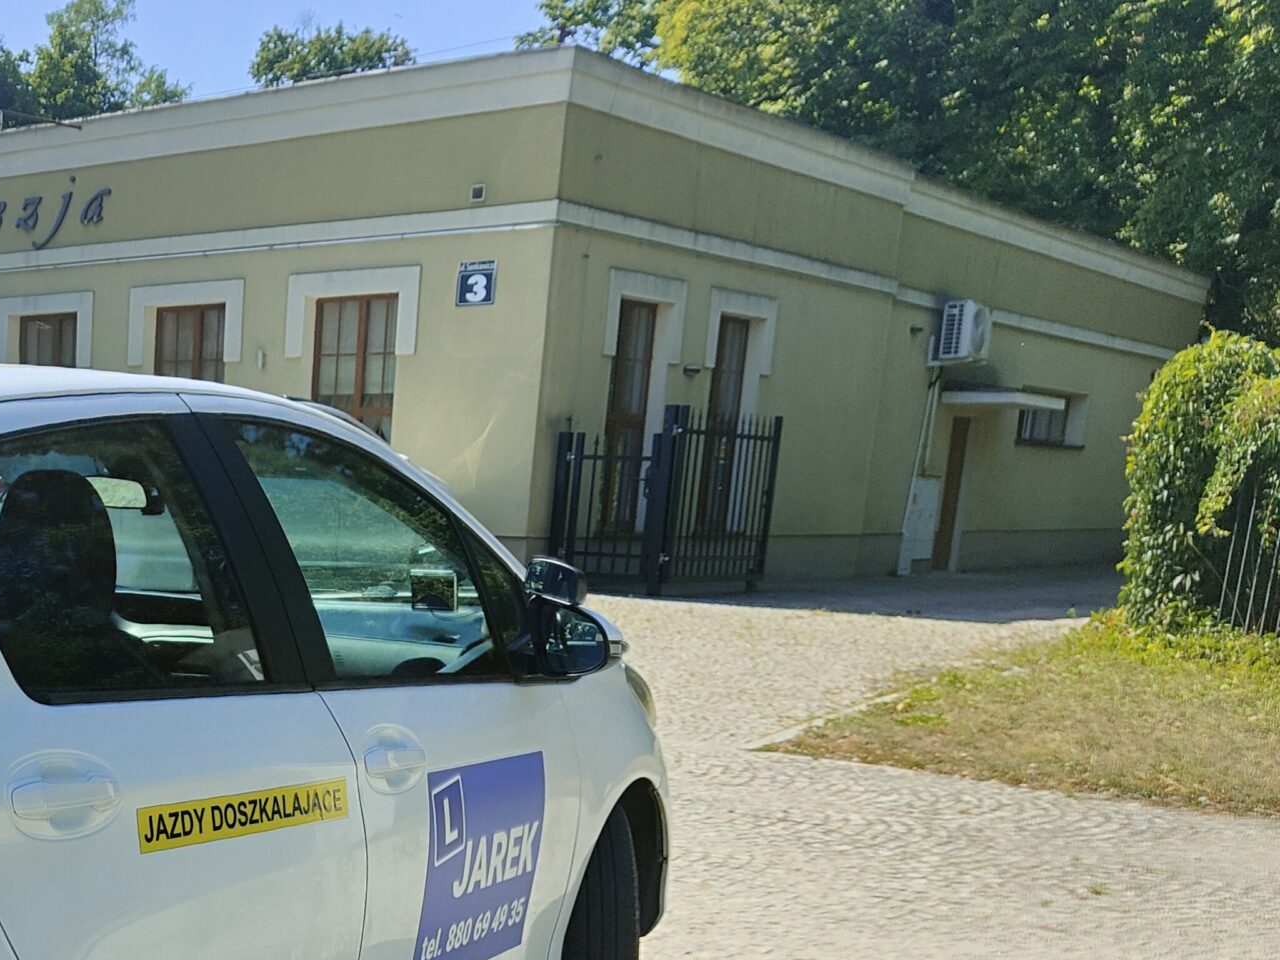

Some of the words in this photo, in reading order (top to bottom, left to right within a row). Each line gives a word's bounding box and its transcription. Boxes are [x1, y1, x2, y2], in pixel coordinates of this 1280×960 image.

[465, 274, 487, 302] 3
[144, 808, 206, 843] JAZDY
[211, 788, 343, 831] DOSZKALAJĄCE
[443, 798, 458, 845] L
[452, 821, 539, 898] JAREK
[446, 918, 472, 952] 880
[473, 911, 491, 940] 69
[491, 903, 508, 933] 49
[508, 897, 525, 927] 35
